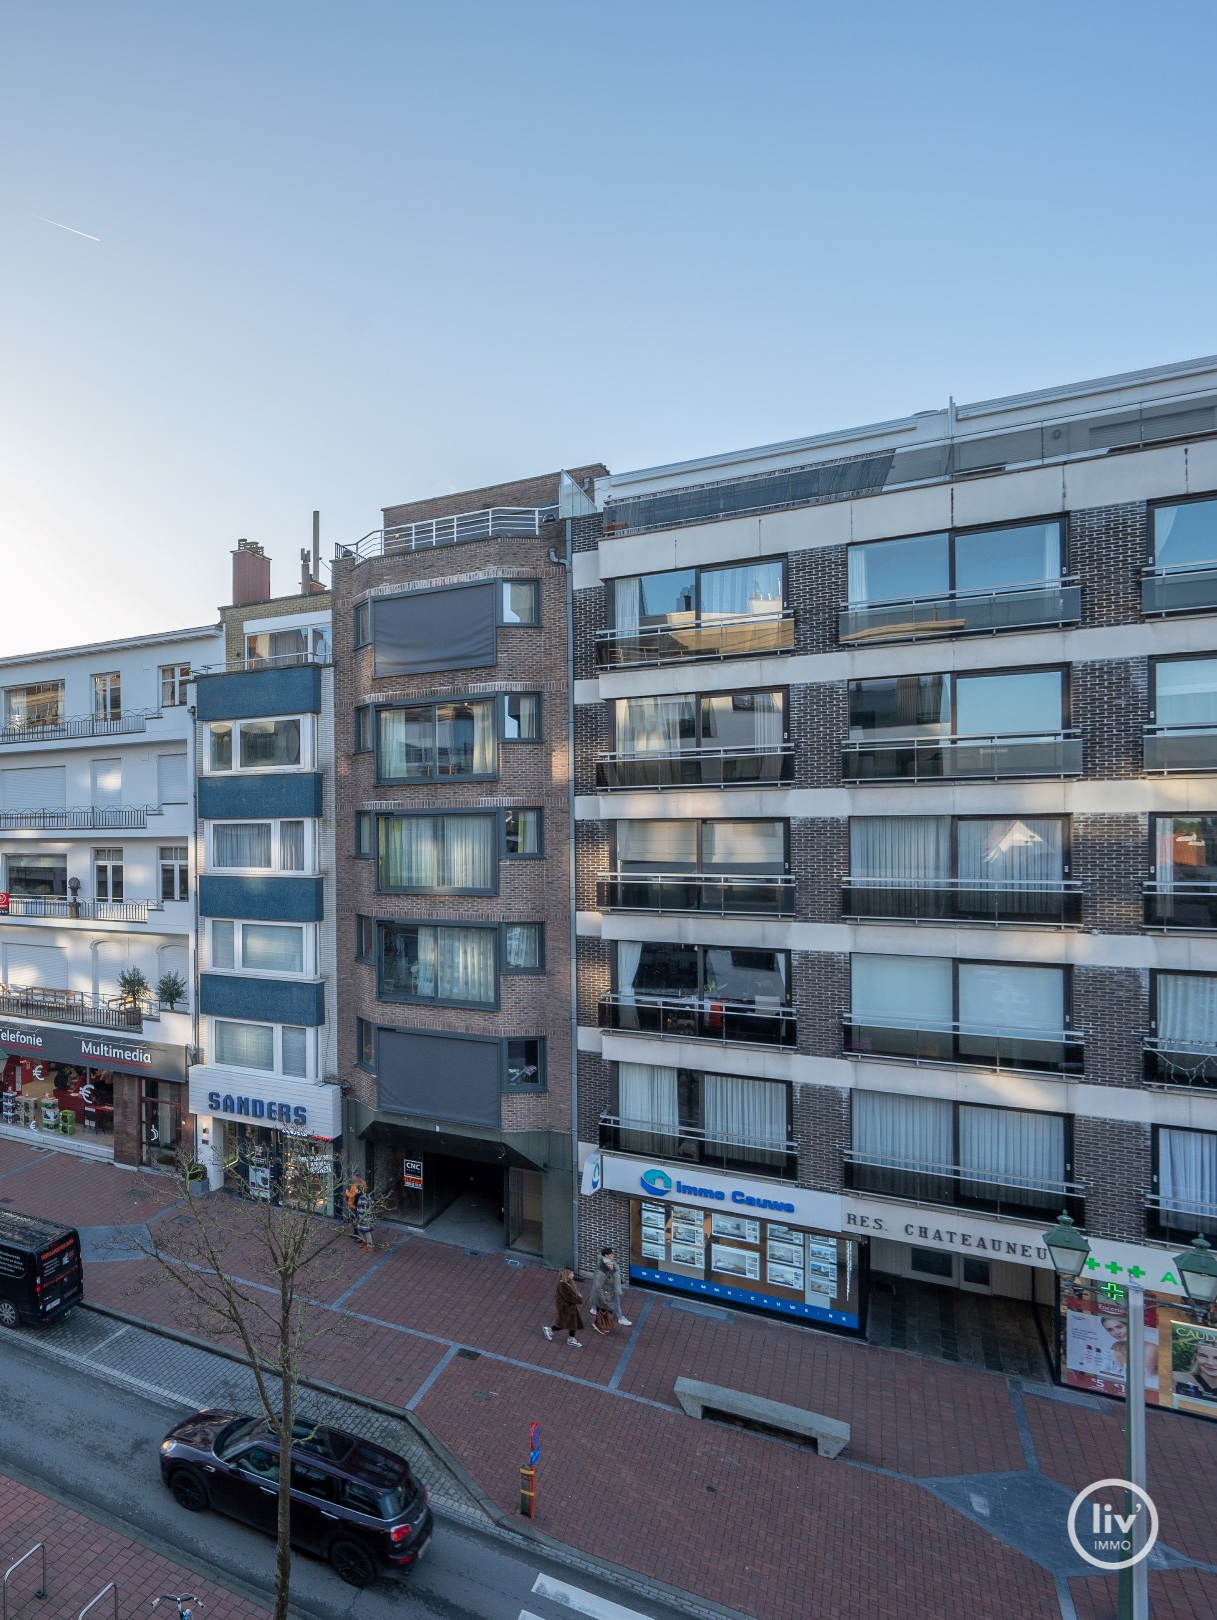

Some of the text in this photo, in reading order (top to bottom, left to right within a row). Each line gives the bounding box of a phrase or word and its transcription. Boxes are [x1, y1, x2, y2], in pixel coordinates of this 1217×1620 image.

[82, 1041, 151, 1064] Multimedia
[208, 1091, 307, 1126] SANDERS
[406, 1162, 421, 1171] CNC
[676, 1181, 795, 1214] Immo Cauwe
[846, 1213, 1049, 1260] RES. CHATEAUNEU
